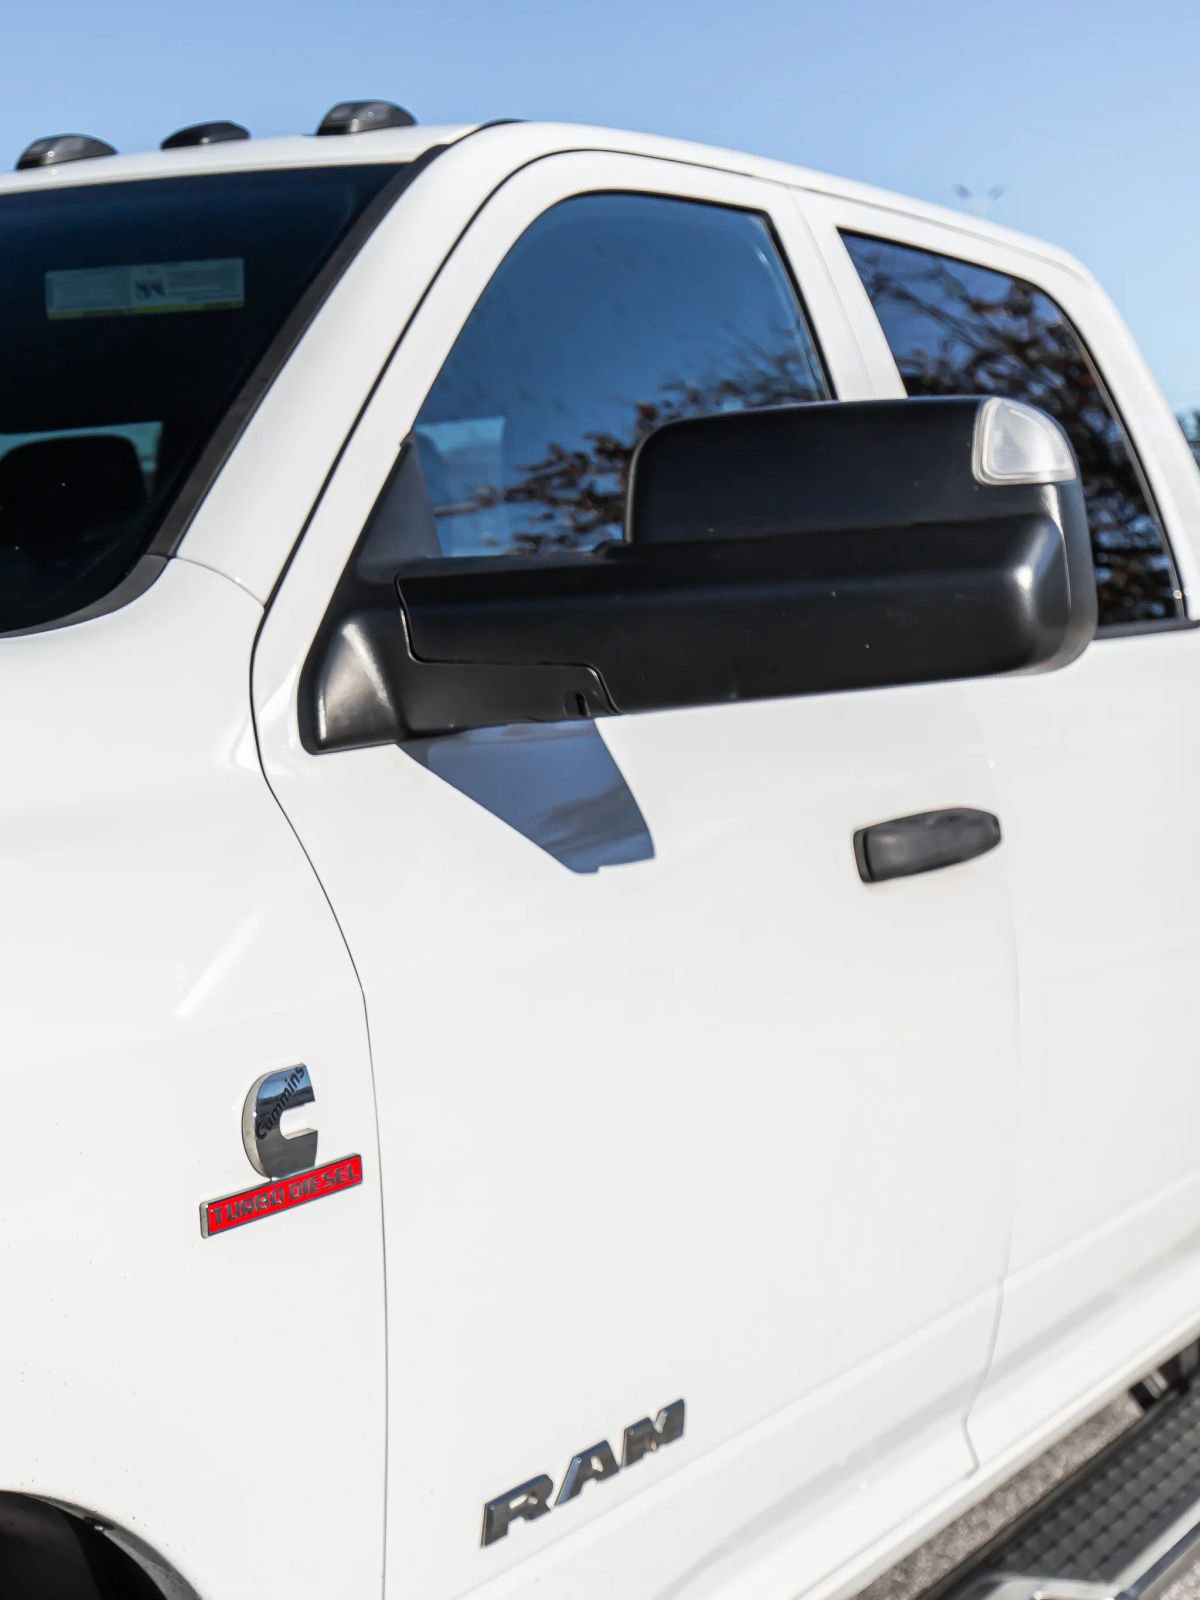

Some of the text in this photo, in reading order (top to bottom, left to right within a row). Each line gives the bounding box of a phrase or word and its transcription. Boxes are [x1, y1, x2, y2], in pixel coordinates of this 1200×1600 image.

[255, 1066, 305, 1140] Cummins
[213, 1165, 359, 1226] TURBO DIESEL
[480, 1398, 686, 1549] RAM
